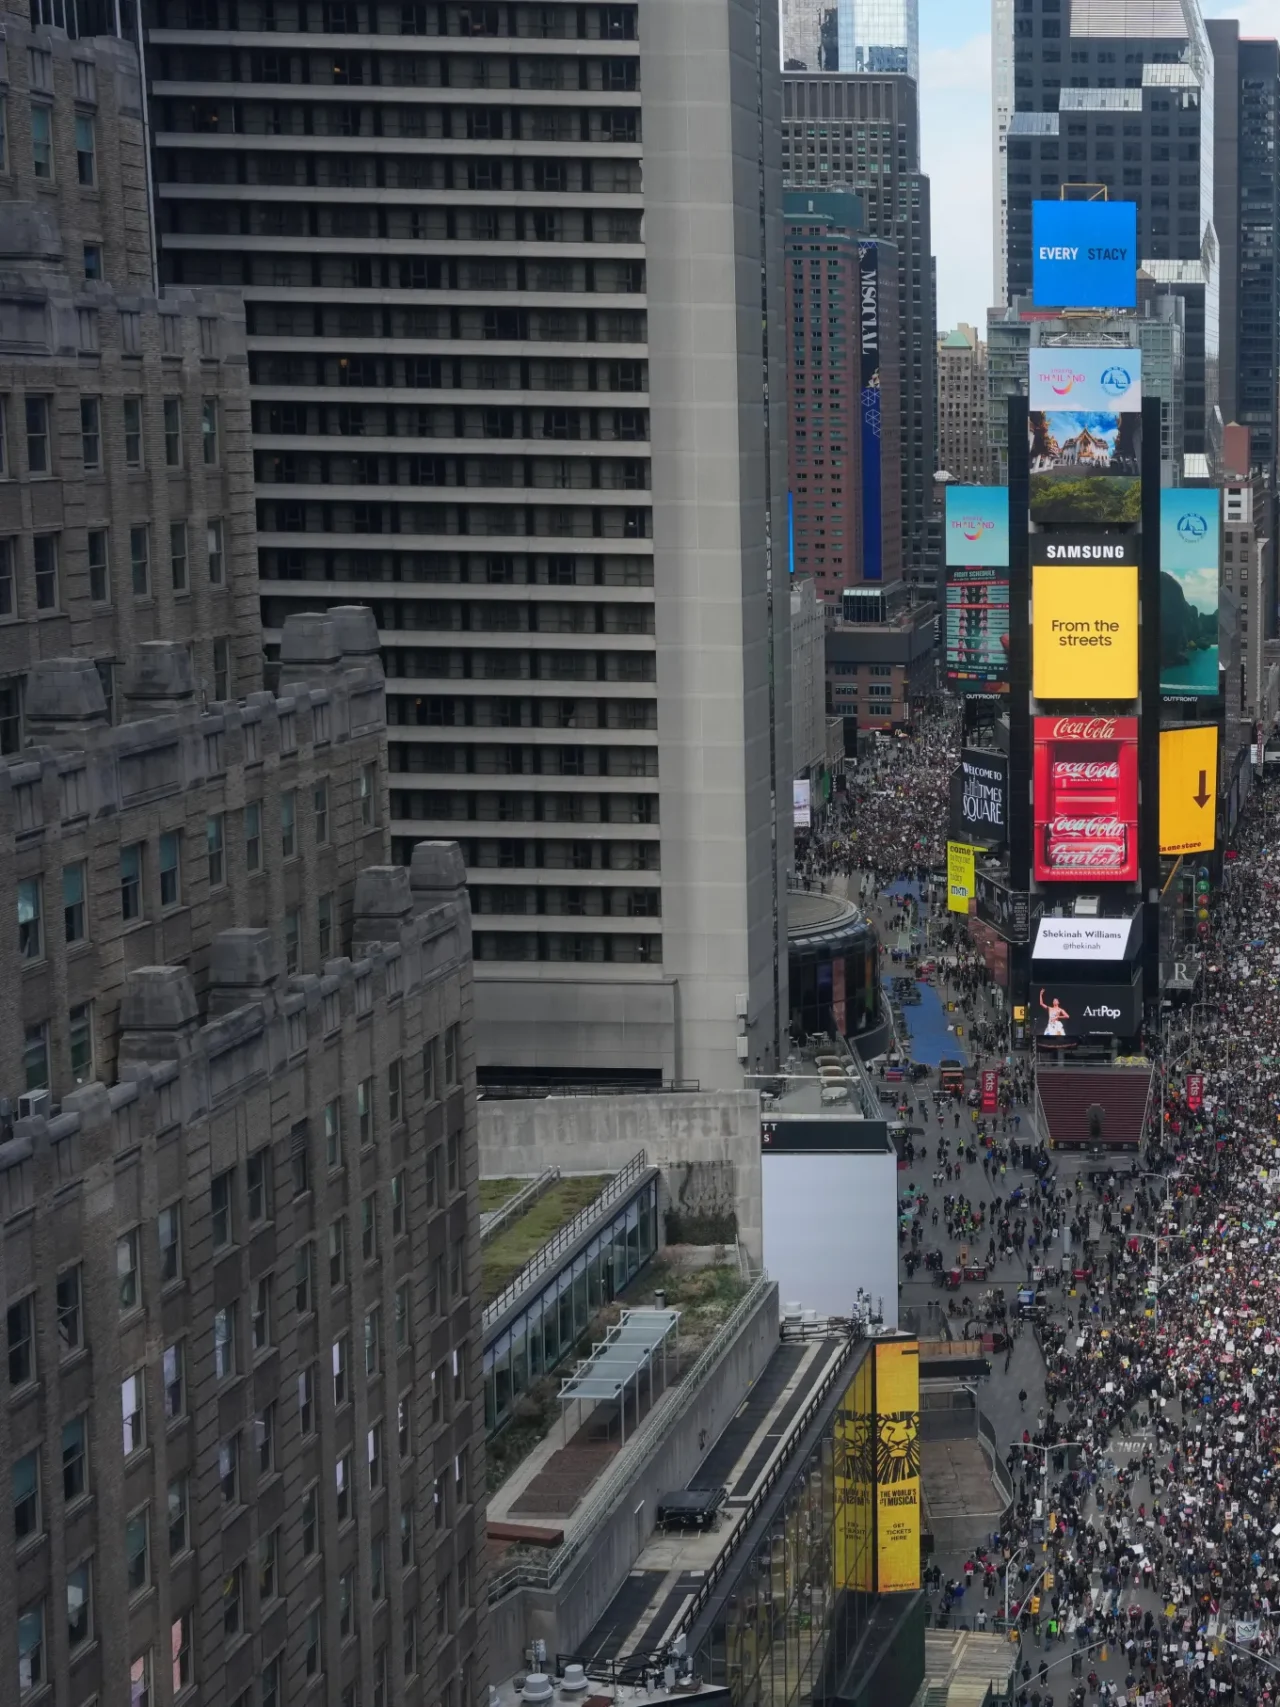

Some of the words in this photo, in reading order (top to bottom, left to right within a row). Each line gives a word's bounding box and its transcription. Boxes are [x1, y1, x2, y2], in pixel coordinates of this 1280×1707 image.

[1039, 246, 1078, 260] EVERY
[1088, 248, 1127, 261] STACY
[1046, 545, 1125, 559] SAMSUNG
[1052, 619, 1090, 632] From
[1094, 619, 1119, 632] the
[1059, 634, 1112, 647] streets
[979, 784, 1003, 803] TIMES
[963, 794, 1004, 825] SQUARE
[949, 845, 971, 856] come
[1167, 843, 1180, 852] one
[1181, 841, 1201, 850] store
[1042, 930, 1082, 938] Shekinah
[1085, 930, 1121, 939] Williams
[1063, 942, 1101, 950] @thekinah
[1174, 962, 1189, 981] R
[1083, 1005, 1121, 1019] ArtPop
[985, 1072, 996, 1092] tkts
[1190, 1077, 1201, 1096] tkts
[880, 1490, 891, 1498] THE
[892, 1488, 917, 1497] WORLD'S
[886, 1496, 918, 1507] MUSICAL
[886, 1528, 912, 1536] TICKETS
